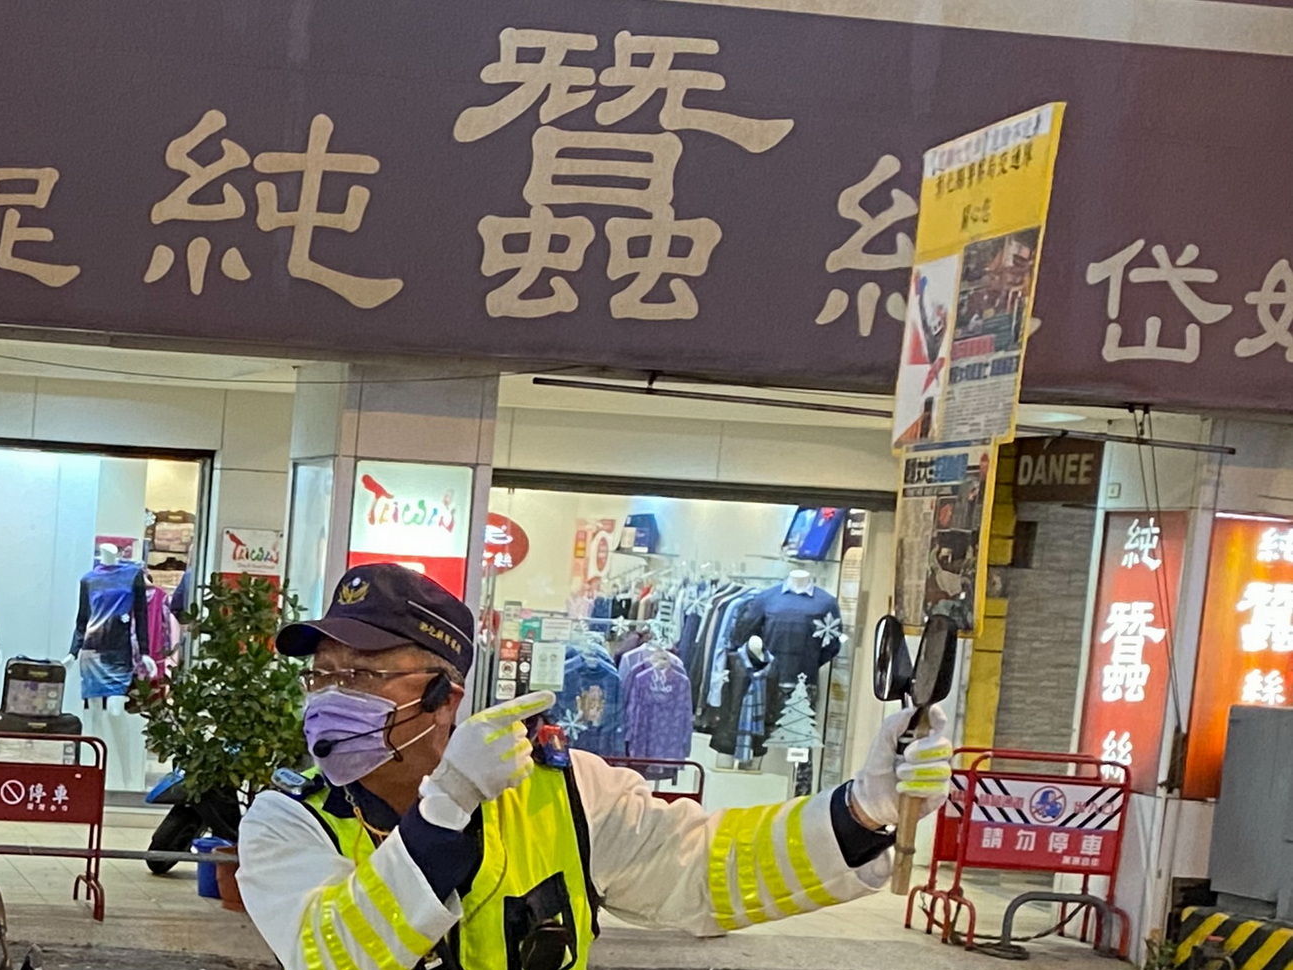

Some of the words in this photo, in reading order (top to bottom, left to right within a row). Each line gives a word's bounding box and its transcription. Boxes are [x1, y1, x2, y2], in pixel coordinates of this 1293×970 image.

[1017, 453, 1093, 486] DANEE
[28, 783, 69, 804] 停車
[981, 827, 1103, 856] 請勿停車
